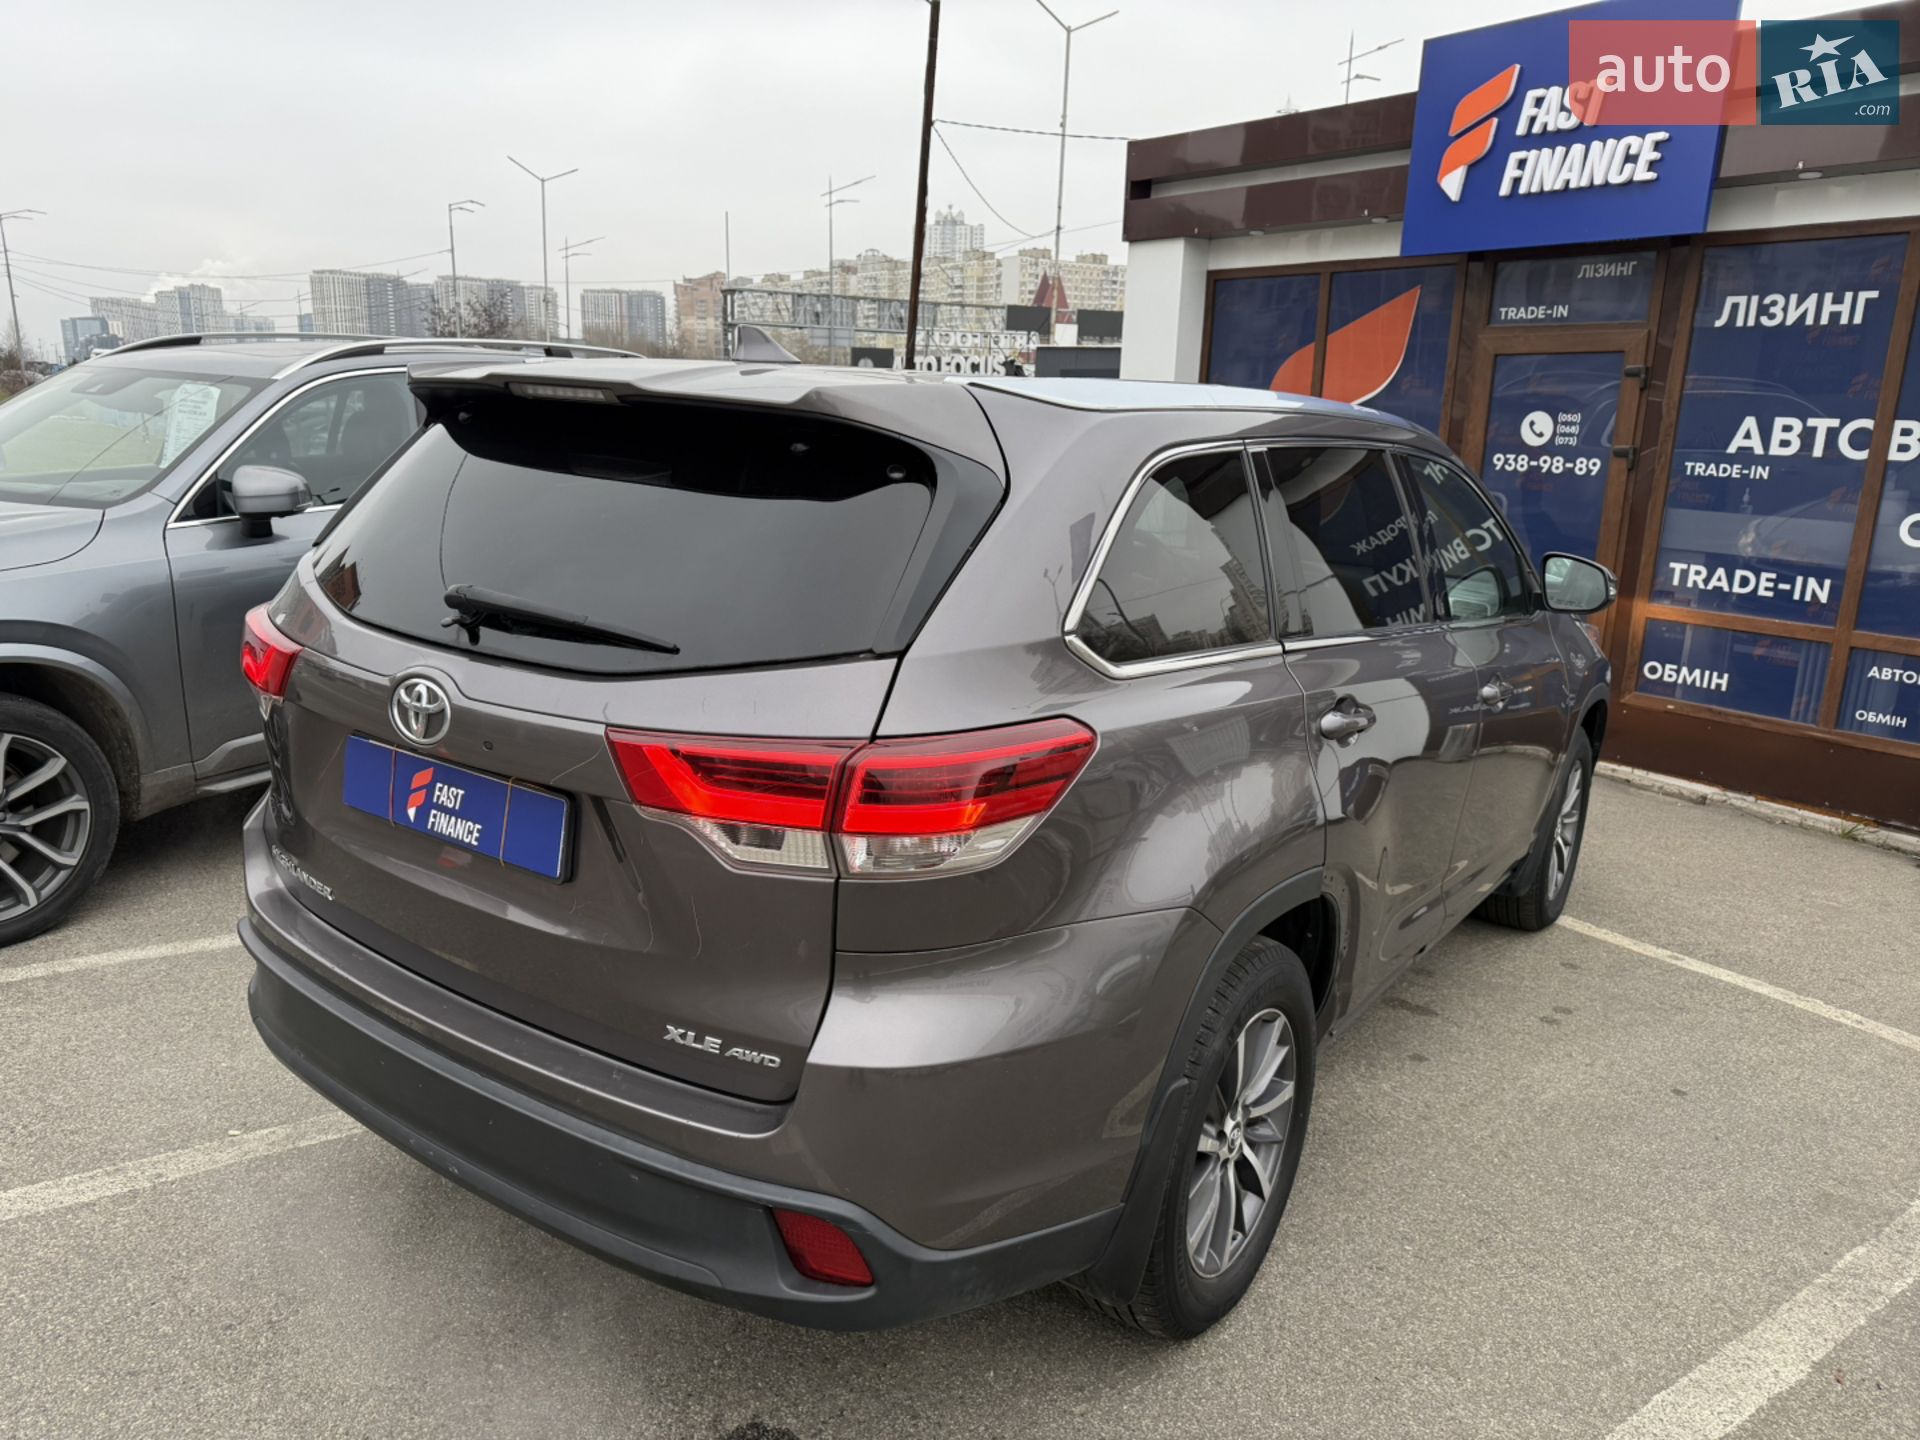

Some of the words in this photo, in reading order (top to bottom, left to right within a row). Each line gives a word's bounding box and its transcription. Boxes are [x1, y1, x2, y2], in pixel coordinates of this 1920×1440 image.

[1516, 76, 1615, 136] FAST
[1499, 131, 1670, 197] FINANCE
[1577, 261, 1637, 279] ЛІЗИНГ
[1500, 304, 1569, 321] TRADE-IN
[1714, 291, 1880, 327] ЛІЗИНГ
[941, 355, 1006, 376] FOCUS
[1558, 412, 1581, 423] (050)
[1555, 436, 1577, 446] (073)
[1493, 453, 1601, 476] 938-98-89
[1684, 461, 1770, 480] TRADE-IN
[1669, 562, 1831, 604] TRADE-IN
[1643, 661, 1729, 692] ОБМІН
[1867, 666, 1920, 685] АВТО
[1855, 709, 1907, 728] ОБМІН
[433, 782, 465, 810] FAST
[427, 809, 482, 846] FINANCE
[663, 1024, 722, 1054] XLE
[724, 1047, 782, 1068] AWD
